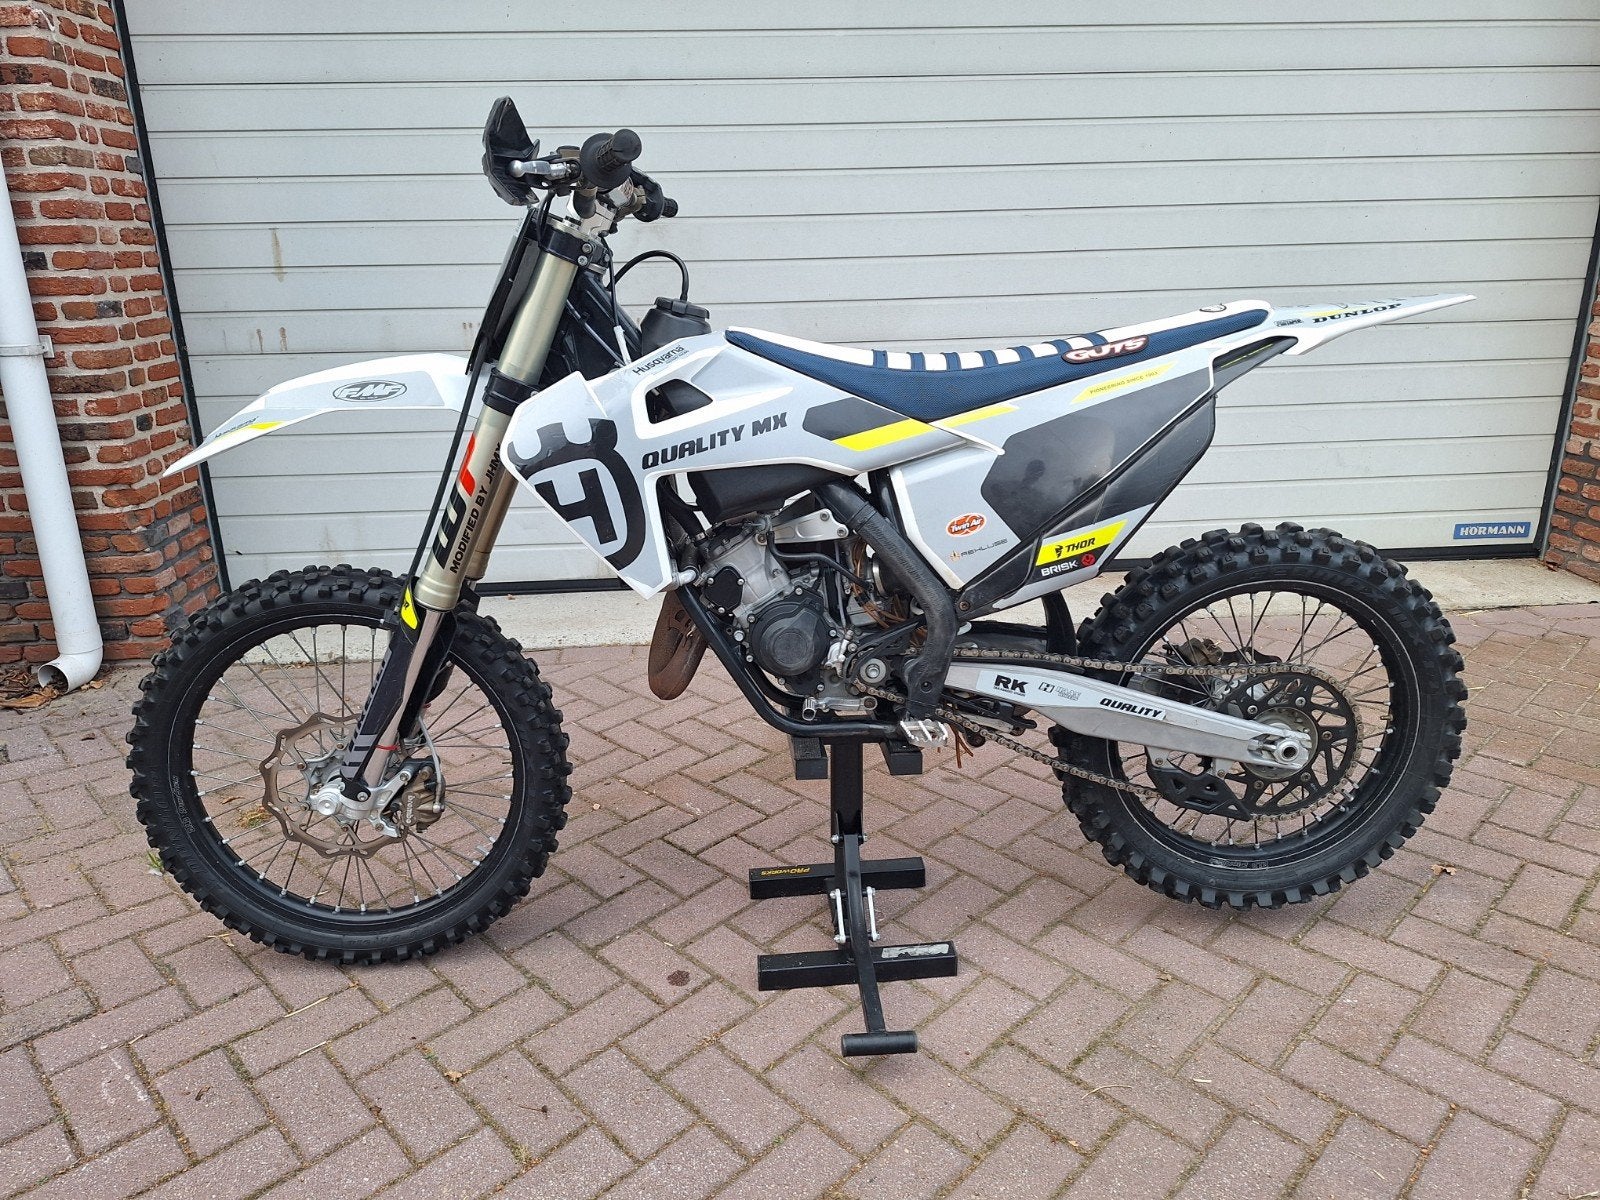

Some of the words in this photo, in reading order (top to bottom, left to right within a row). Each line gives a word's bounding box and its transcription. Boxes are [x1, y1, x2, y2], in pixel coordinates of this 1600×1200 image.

[1312, 303, 1402, 323] DUNLOP
[1065, 336, 1147, 361] GUTS
[632, 345, 685, 375] Husqvarna
[1090, 379, 1126, 394] PIONEERING
[641, 424, 745, 471] QUALITY
[751, 412, 788, 436] MX
[450, 508, 480, 574] MODIFIED
[475, 484, 489, 507] BY
[951, 521, 970, 534] Twin
[969, 516, 983, 528] Air
[1064, 537, 1096, 553] THOR
[1040, 560, 1078, 577] BRISK
[994, 674, 1029, 694] RK
[1099, 697, 1163, 718] QUALITY
